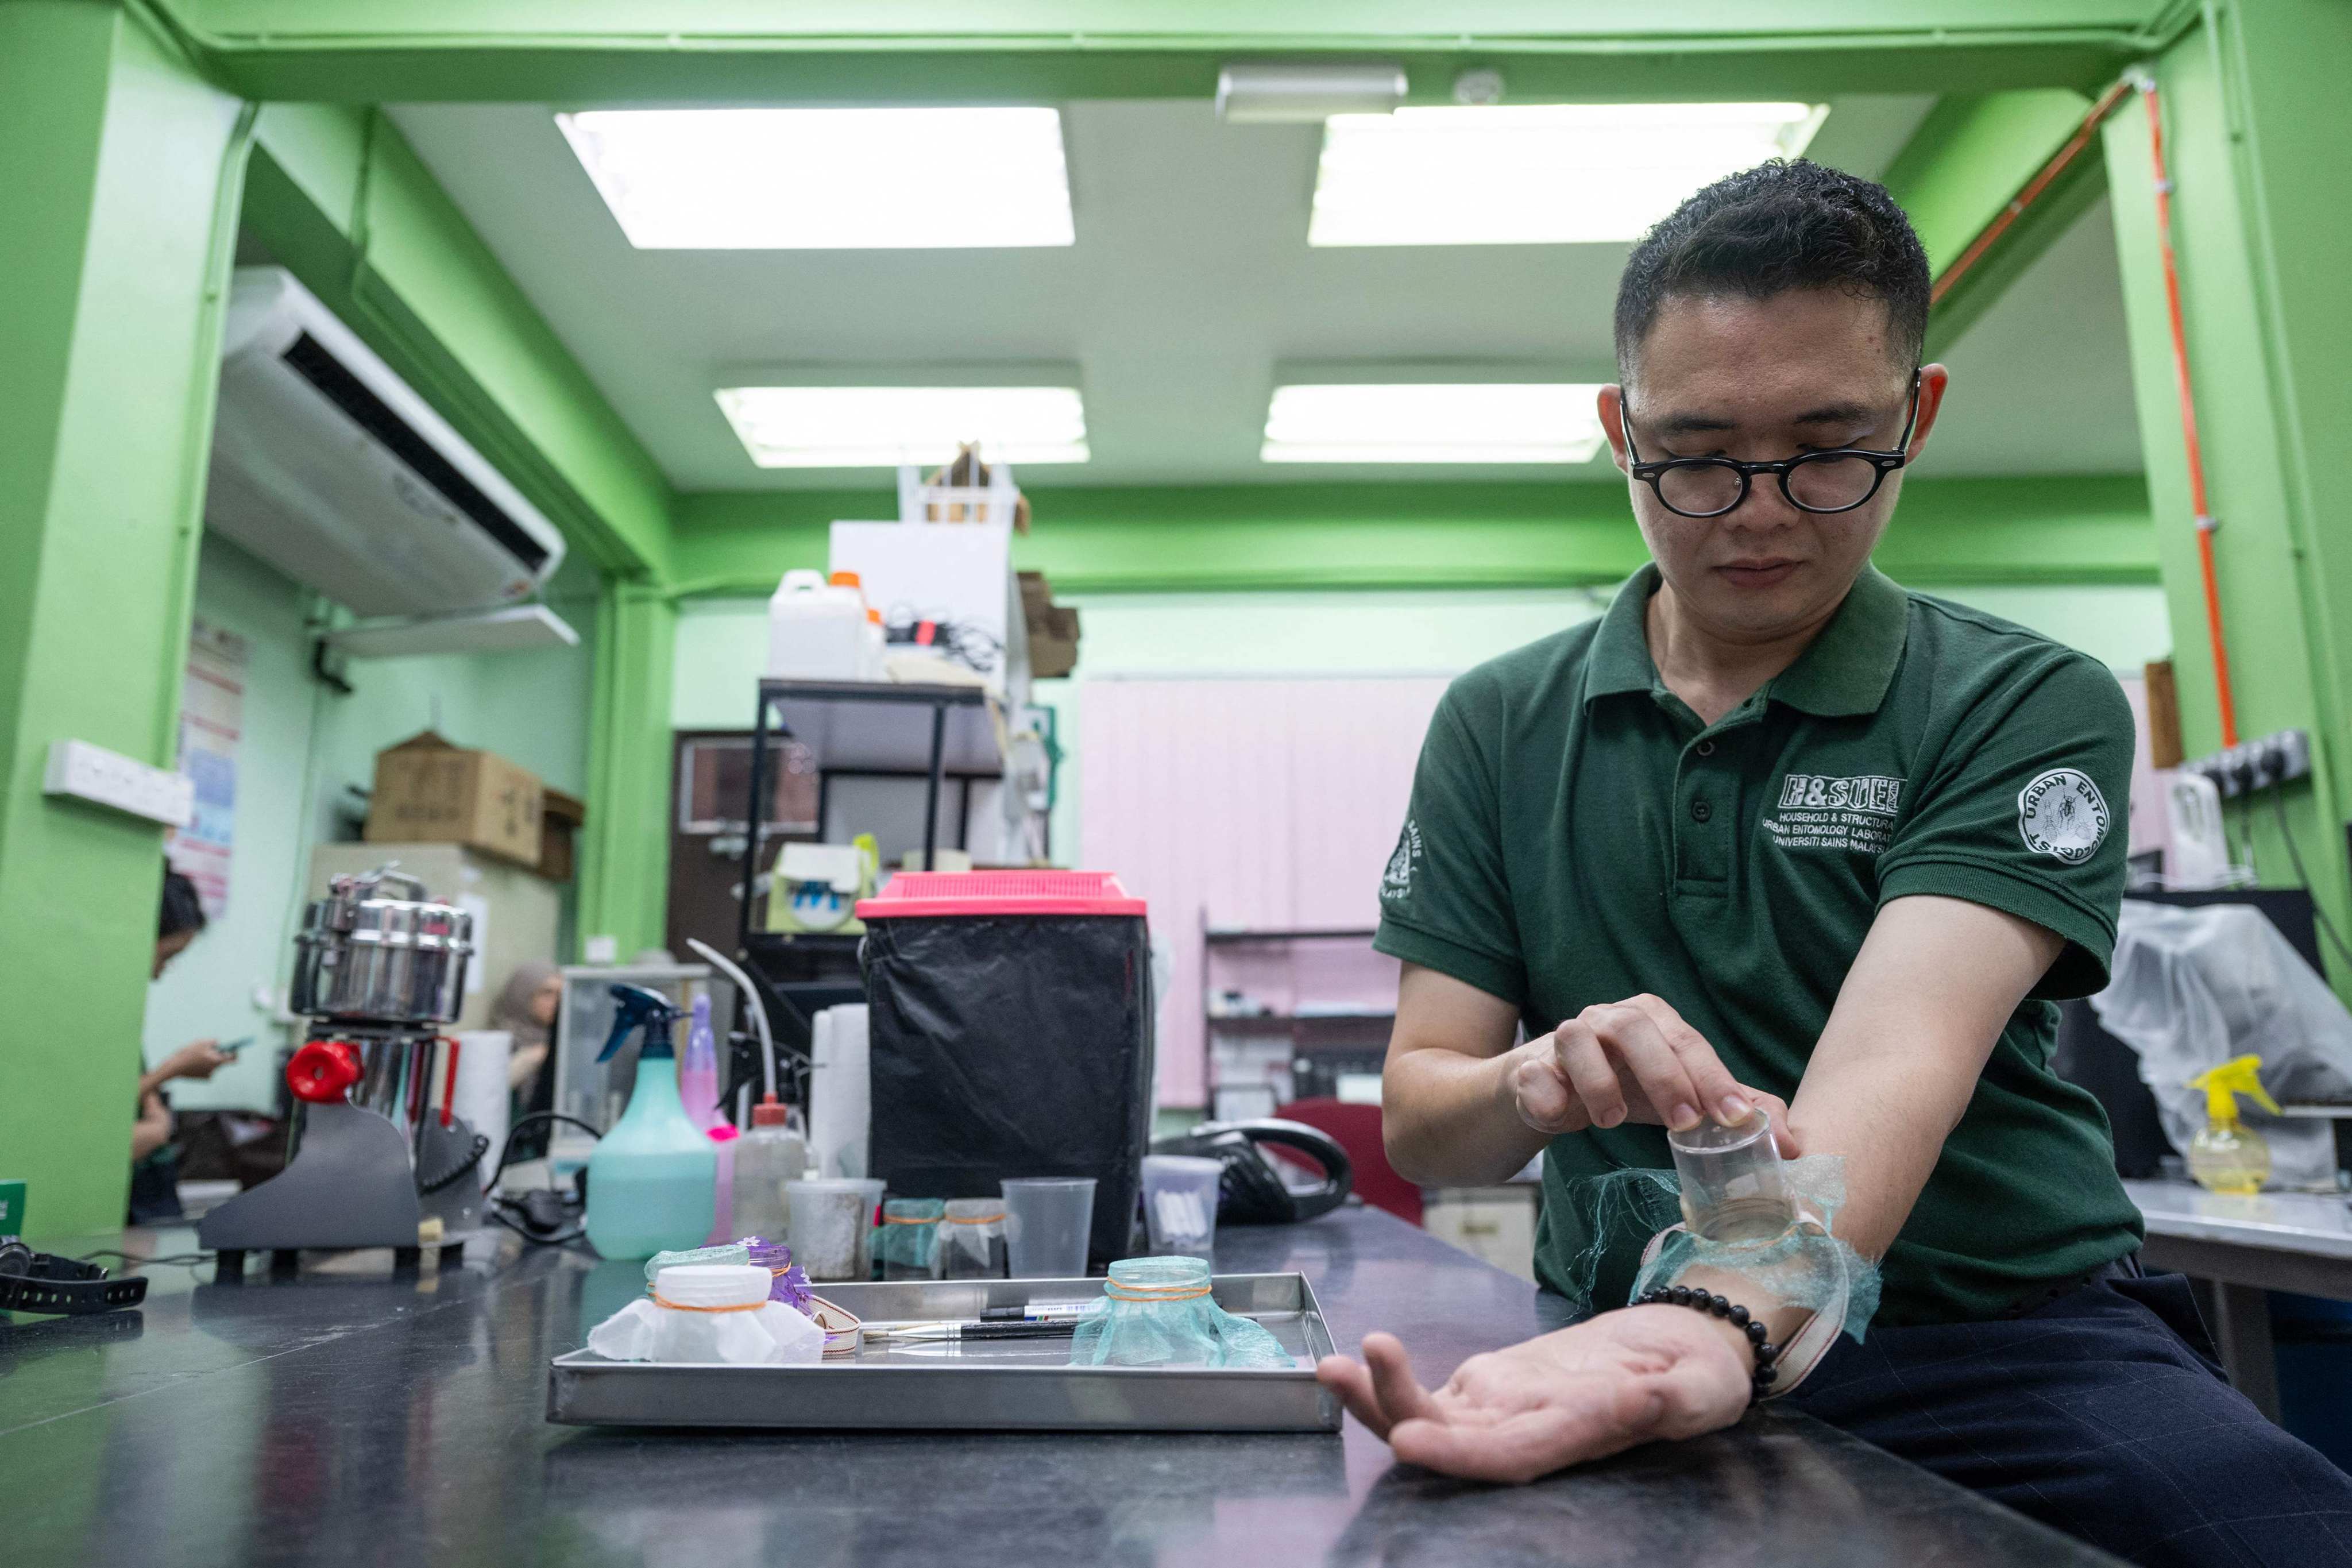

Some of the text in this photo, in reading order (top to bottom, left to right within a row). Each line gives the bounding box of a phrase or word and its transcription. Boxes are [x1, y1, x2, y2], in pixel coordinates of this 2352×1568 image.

[2026, 775, 2067, 819] URBAN
[1779, 812, 1829, 822] HOUSEHOLD
[1831, 812, 1837, 822] &
[1762, 817, 1790, 833] URBAN
[1793, 824, 1848, 836] ENTOMOLOGY
[1773, 835, 1820, 847] UNIVERSITI
[1821, 836, 1848, 848] SAINS
